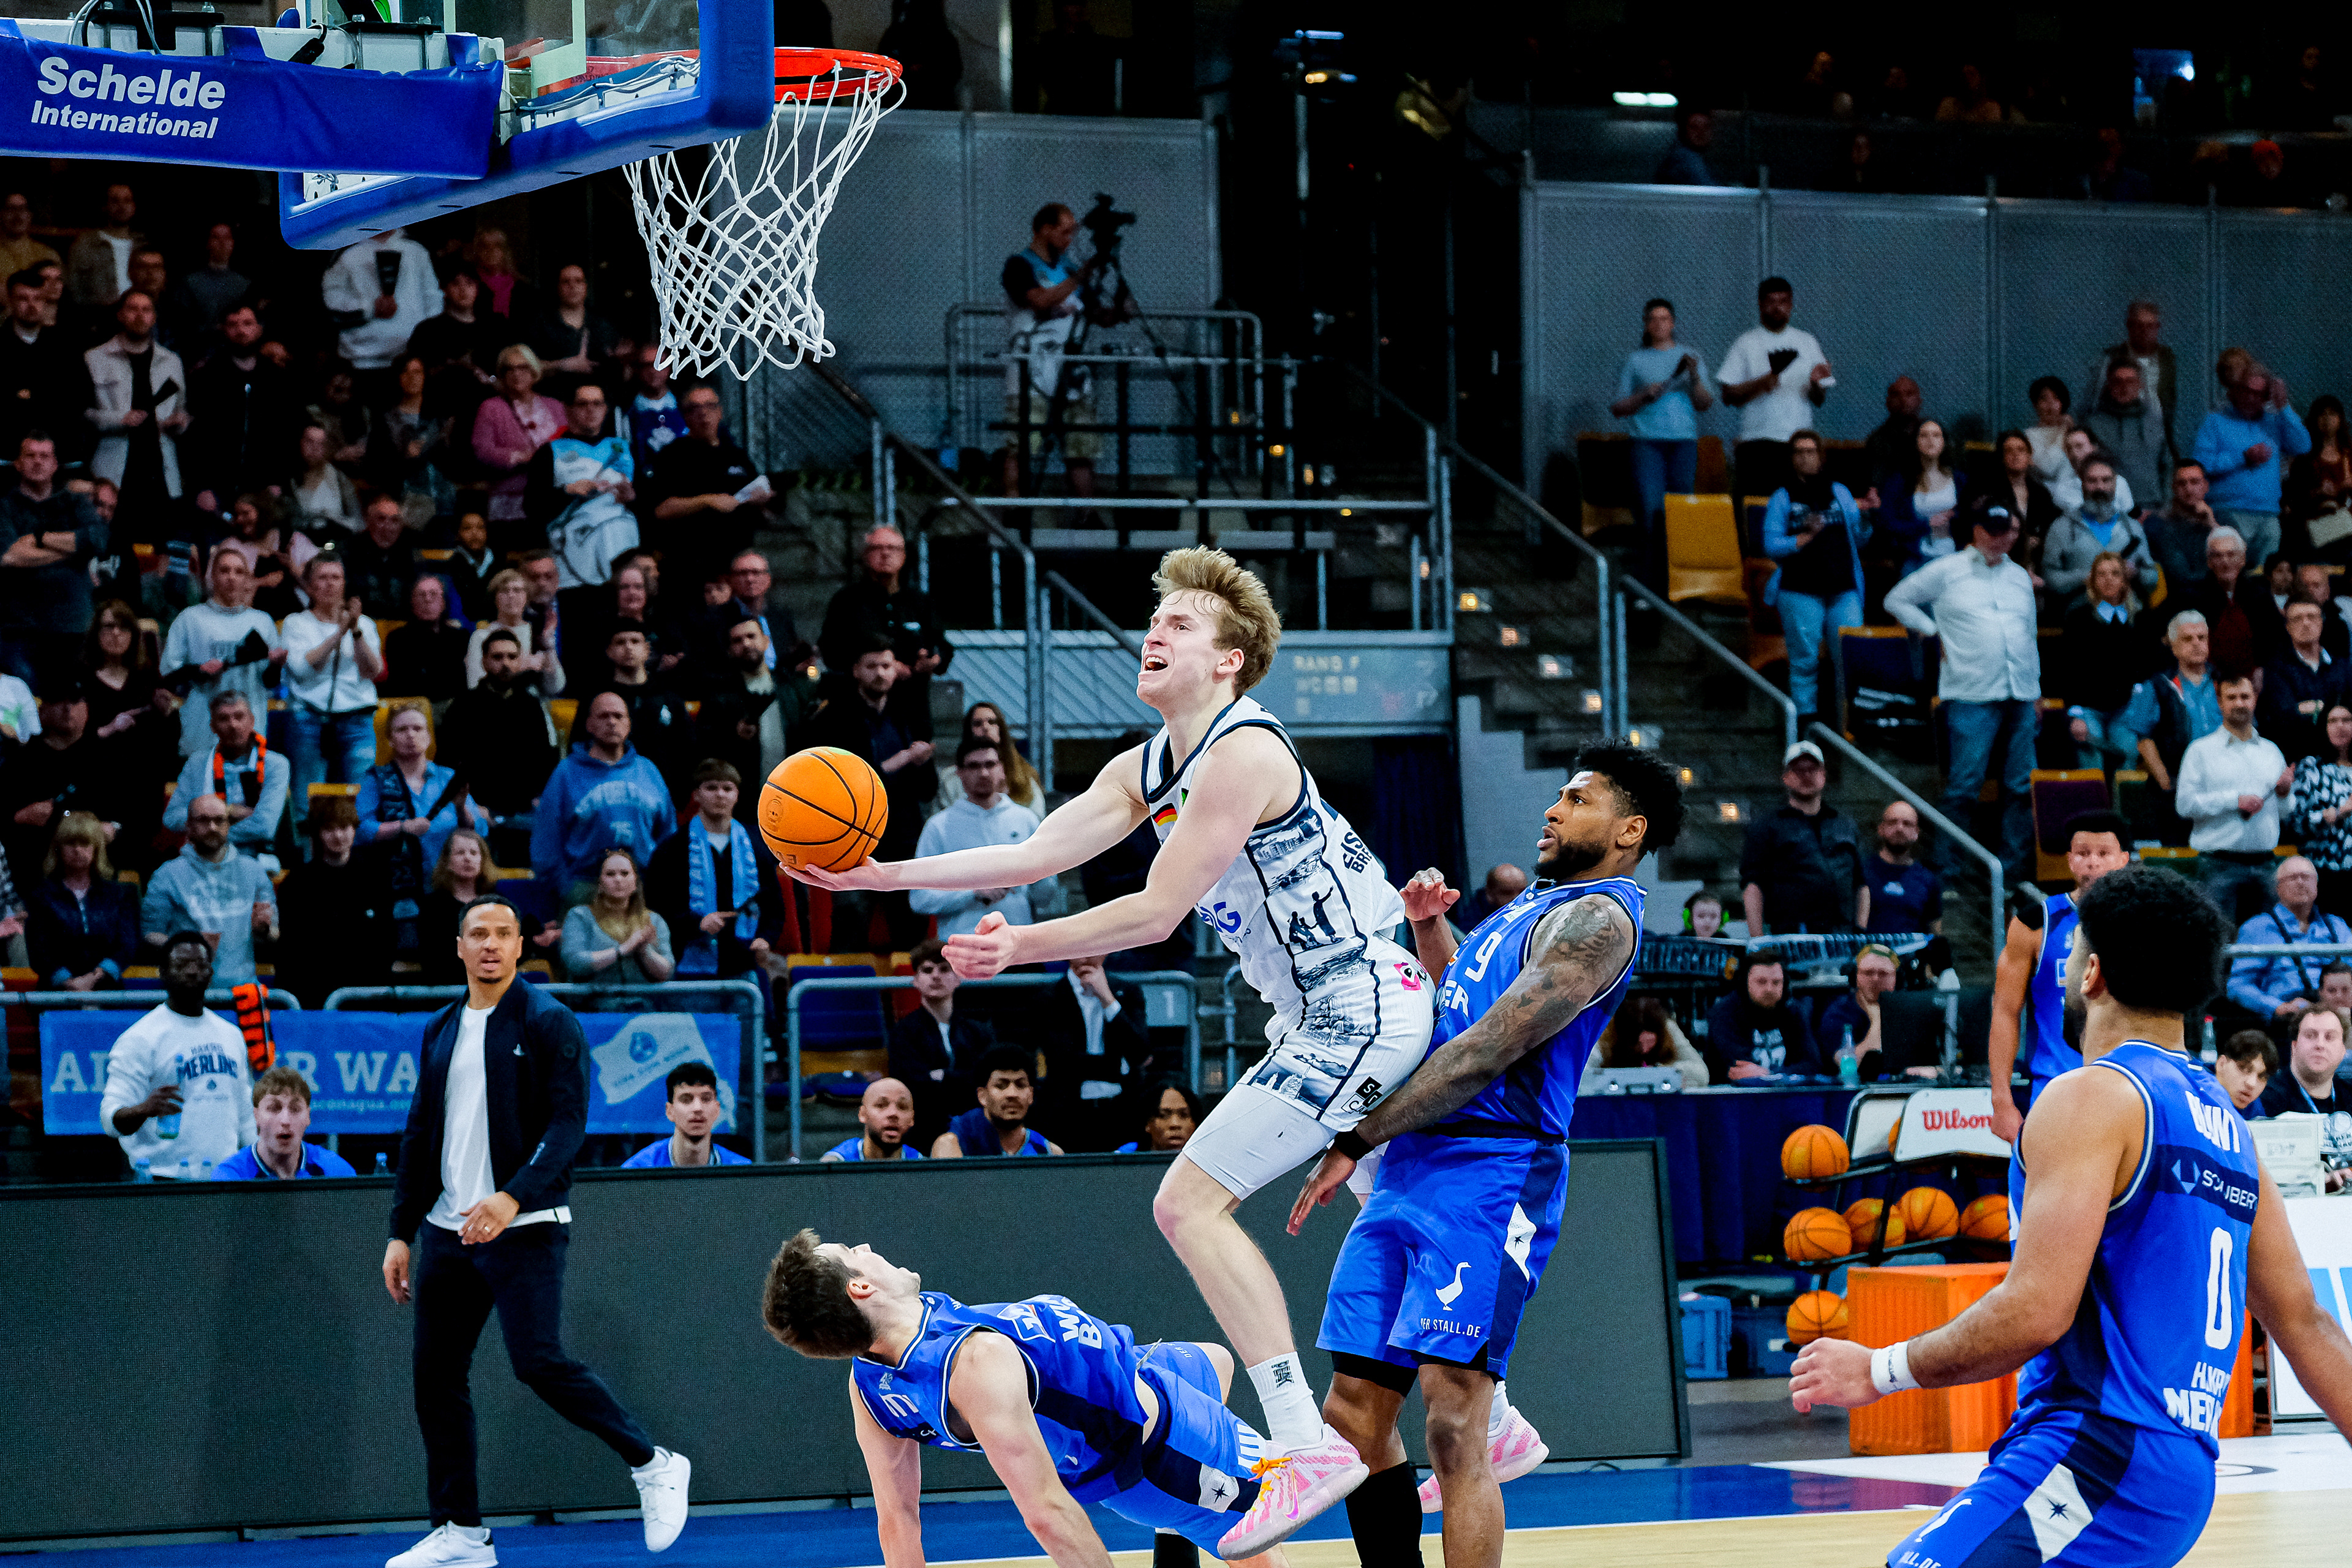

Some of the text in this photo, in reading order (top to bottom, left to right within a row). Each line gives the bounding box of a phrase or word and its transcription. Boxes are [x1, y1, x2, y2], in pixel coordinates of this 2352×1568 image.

[37, 56, 225, 109] Schelde
[31, 100, 218, 138] International
[1464, 930, 1503, 982] 9
[1922, 1108, 1993, 1132] Wilson
[2204, 1226, 2233, 1350] 0
[1433, 1319, 1481, 1338] STALL.DE
